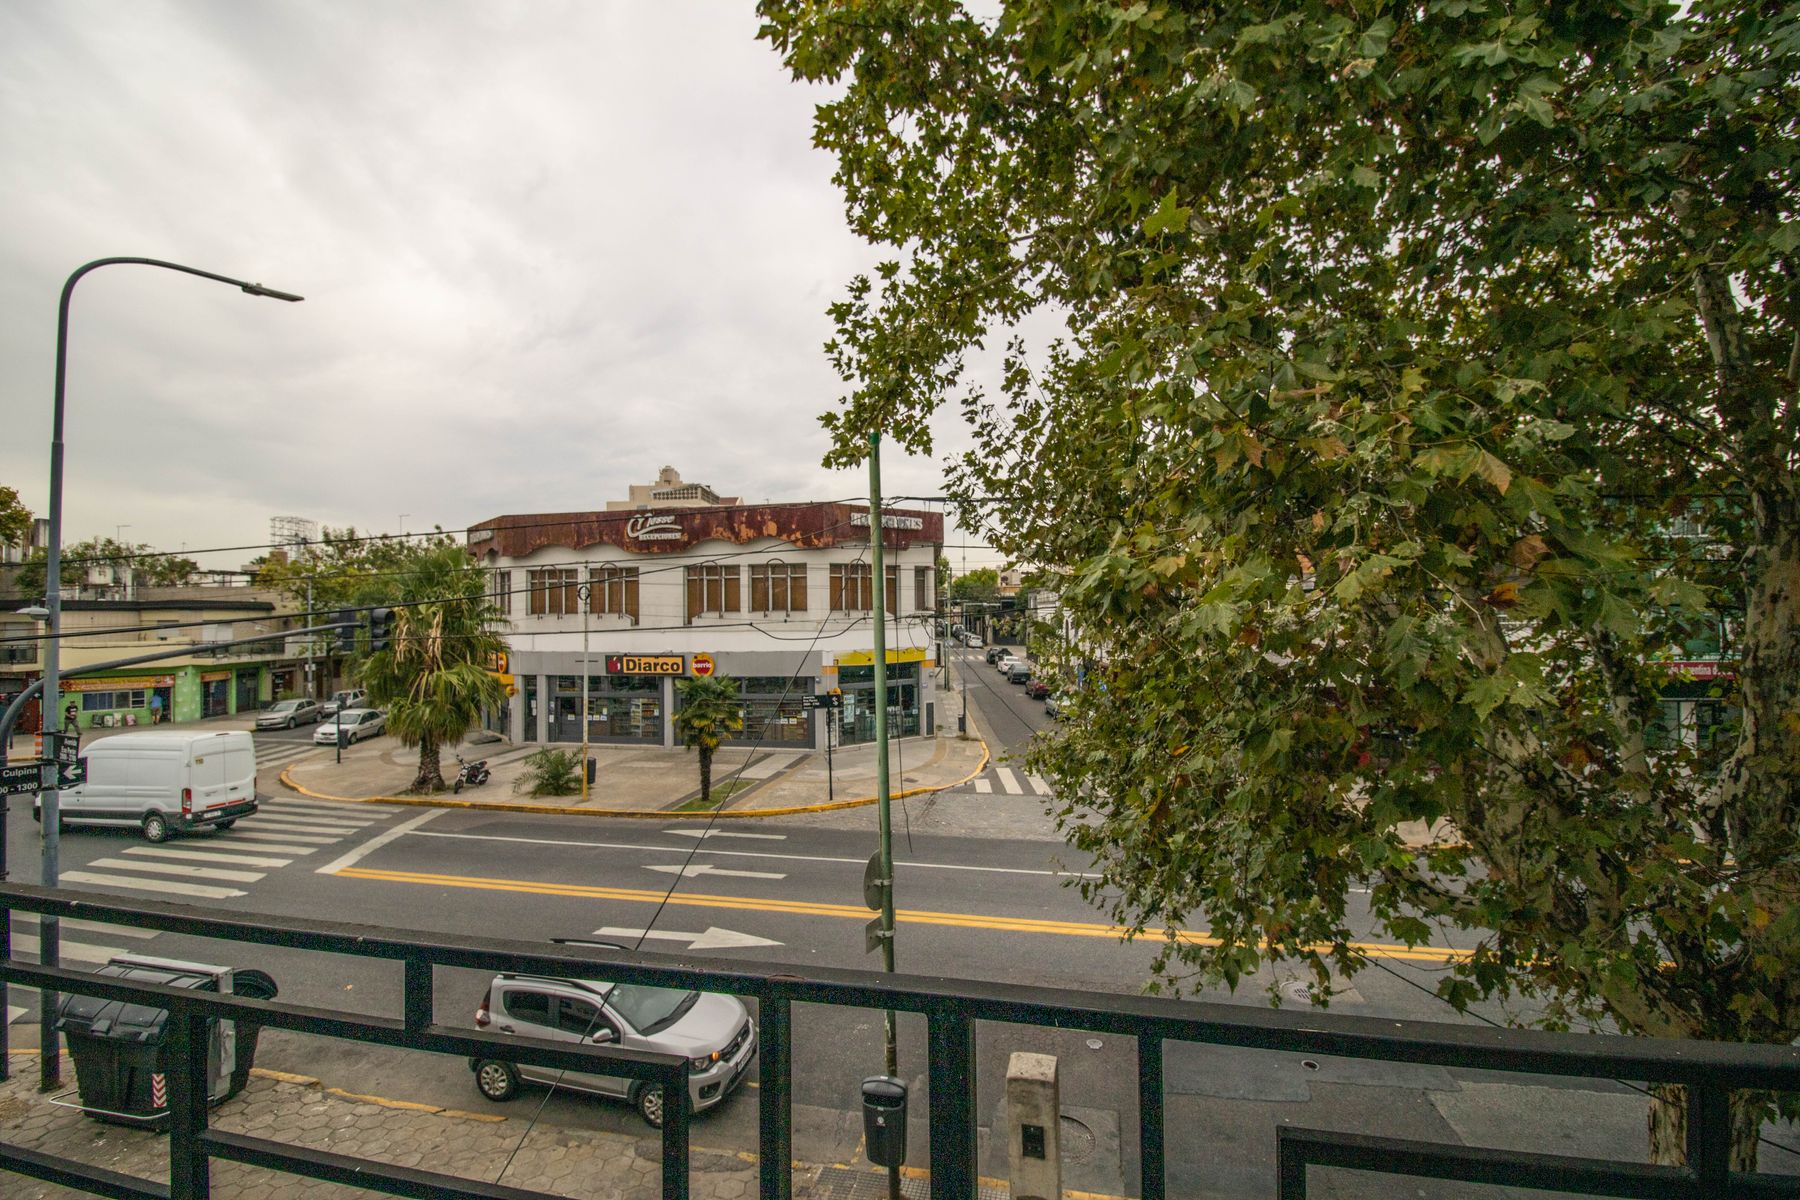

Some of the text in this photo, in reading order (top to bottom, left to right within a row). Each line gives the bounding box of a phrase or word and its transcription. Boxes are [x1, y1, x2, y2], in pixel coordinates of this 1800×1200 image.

[625, 658, 681, 672] Diarco
[692, 661, 712, 669] barrio
[2, 767, 38, 778] Culpina
[16, 782, 38, 792] 1300
